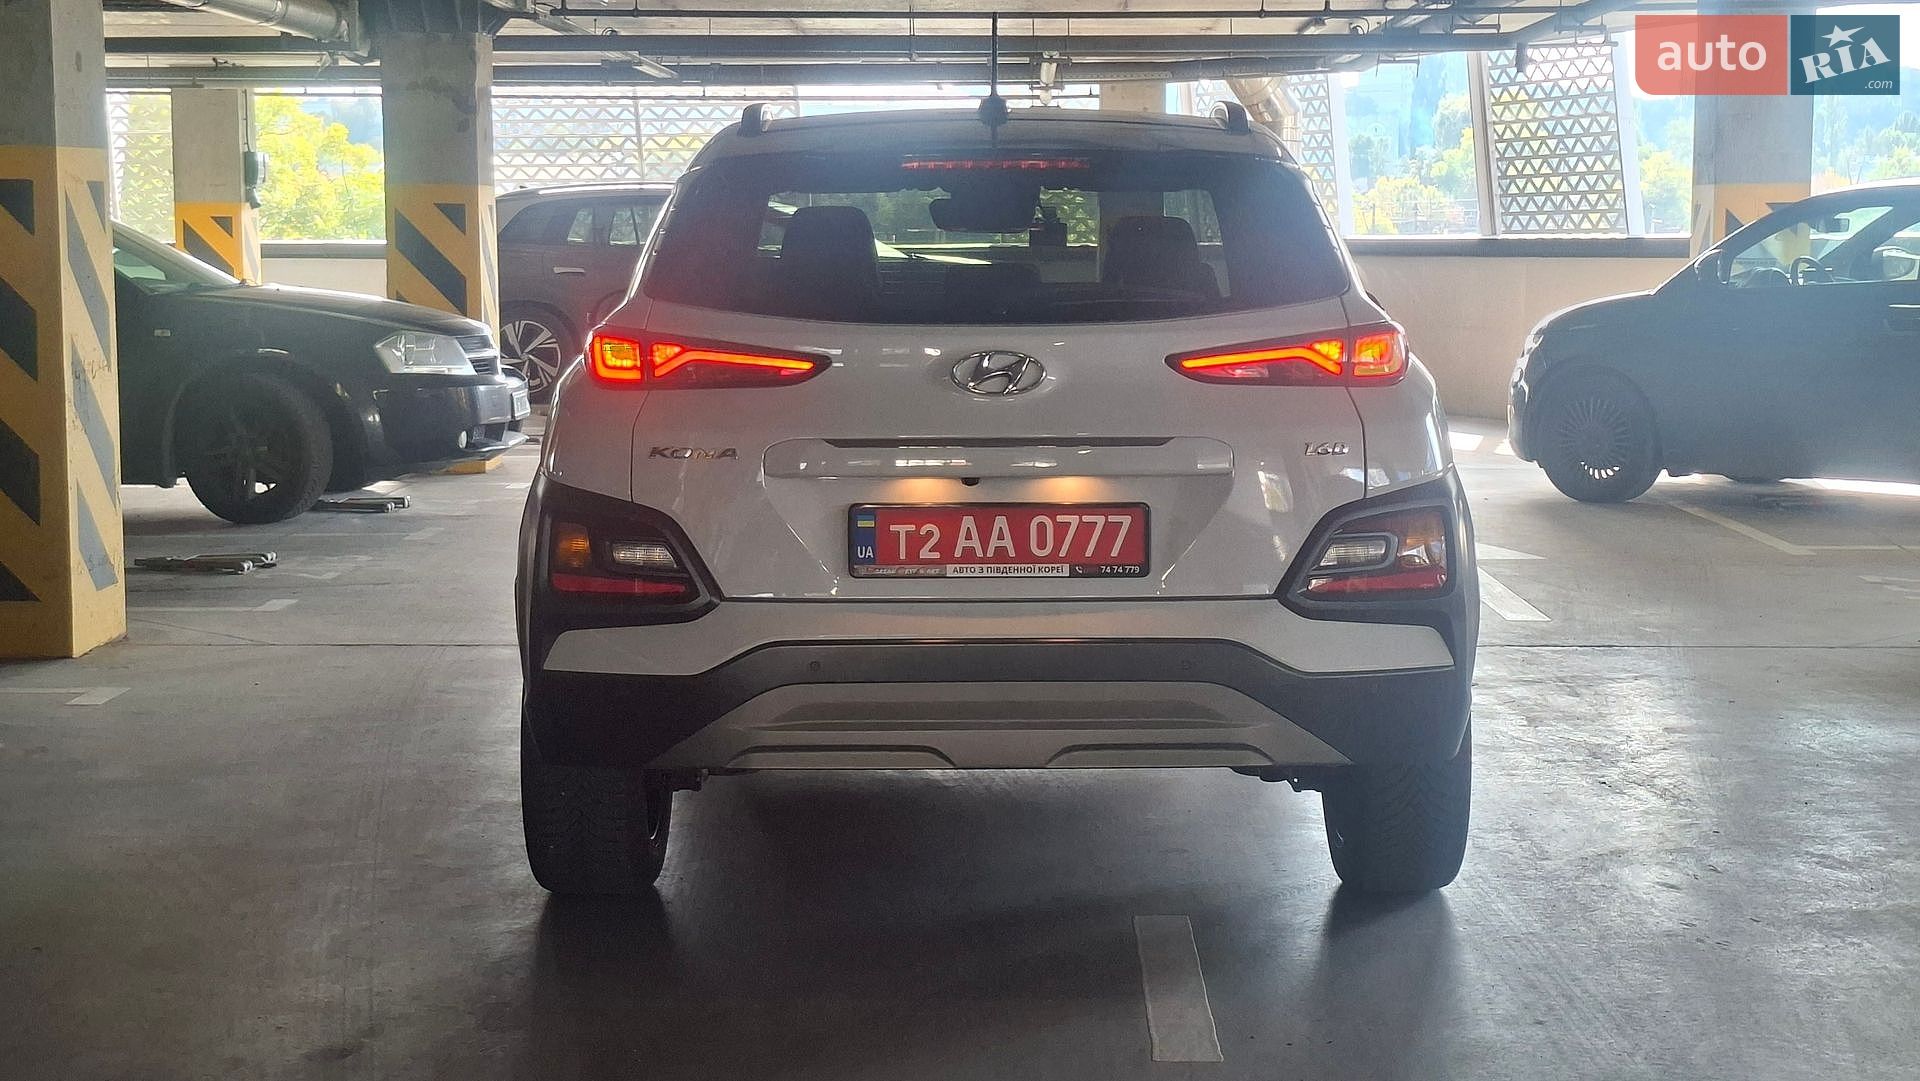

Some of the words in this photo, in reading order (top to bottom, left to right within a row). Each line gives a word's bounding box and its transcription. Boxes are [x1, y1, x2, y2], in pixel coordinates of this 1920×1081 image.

[648, 446, 739, 460] KONA
[889, 523, 941, 560] T2
[953, 515, 1016, 558] AA
[1028, 514, 1132, 558] 0777
[857, 546, 874, 559] UA
[952, 566, 976, 574] АВТО
[986, 564, 1036, 575] ПІВДЕННОЇ
[1038, 564, 1064, 574] КОРЕЇ
[1100, 566, 1110, 574] 74
[1112, 566, 1123, 574] 74
